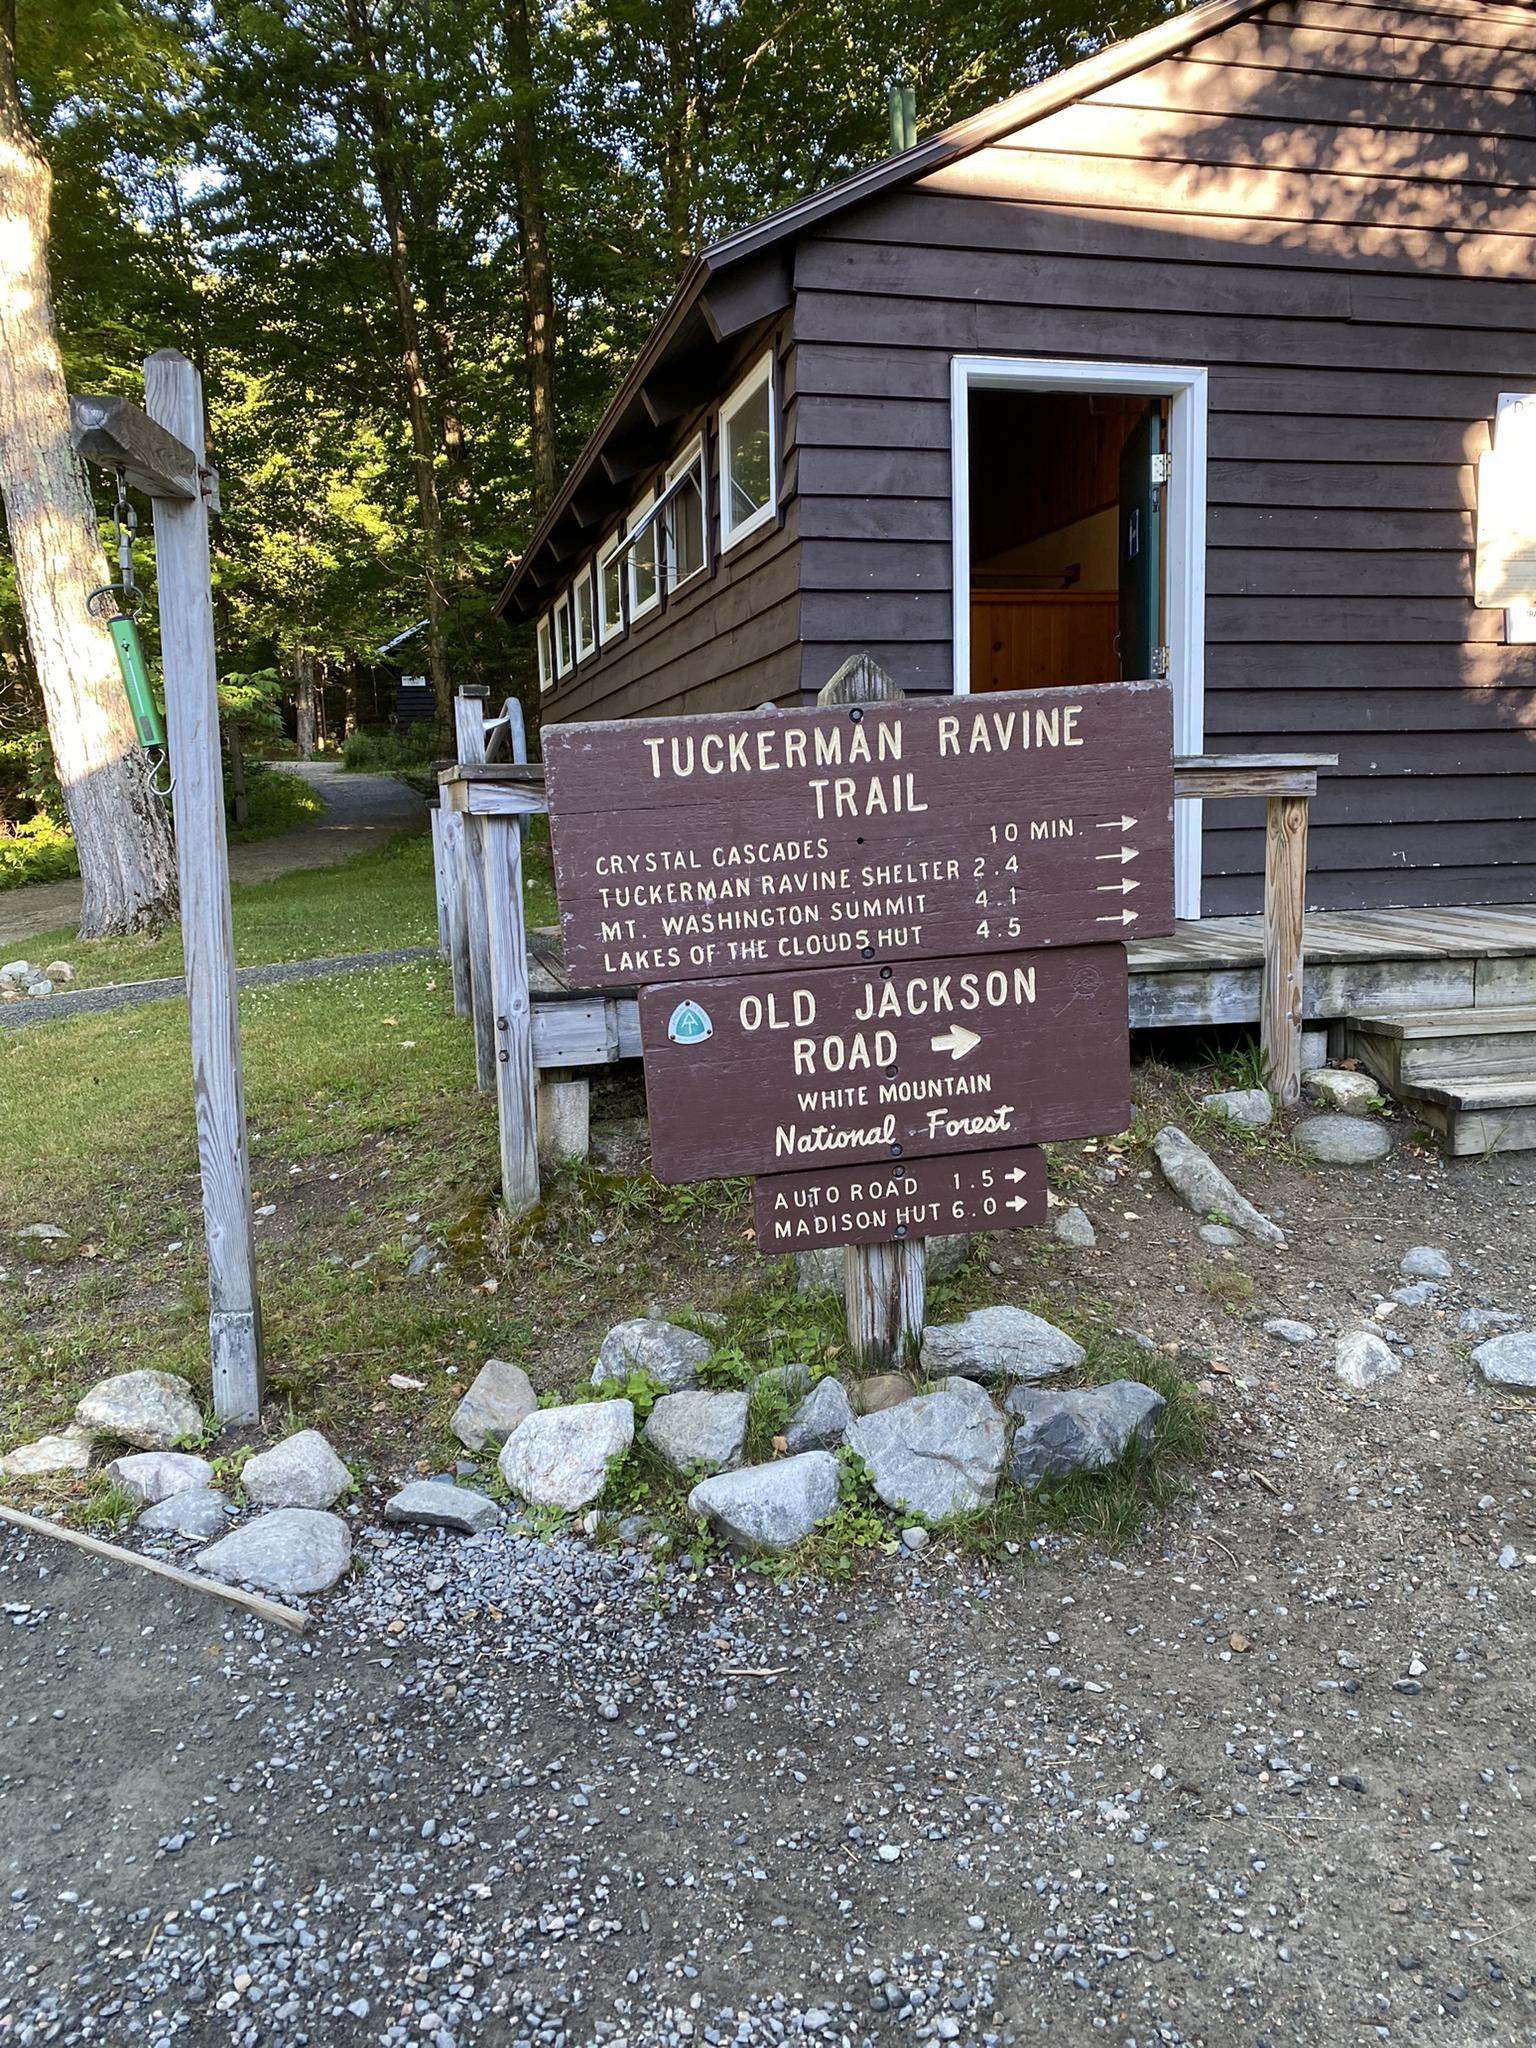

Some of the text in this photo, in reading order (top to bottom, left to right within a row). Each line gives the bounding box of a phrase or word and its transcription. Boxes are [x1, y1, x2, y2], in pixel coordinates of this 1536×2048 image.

[644, 705, 1084, 778] TUCKERMAN RAVINE
[809, 774, 928, 820] TRAIL
[595, 819, 1084, 876] CRYSTAL CASCADES 10 MIN.
[599, 878, 750, 910] TUCKERMAN
[761, 870, 850, 895] RAVINE
[862, 860, 960, 887] SHELTER
[601, 921, 646, 943] MT.
[662, 906, 819, 937] WASHINGTON
[831, 894, 926, 921] SUMMIT
[603, 948, 681, 973] LAKES
[690, 944, 716, 965] OF
[727, 939, 769, 961] THE
[778, 930, 870, 958] CLOUDS
[878, 926, 923, 948] HUT
[739, 989, 816, 1031] OLD
[855, 967, 1036, 1021] JACKSON
[793, 1030, 897, 1075] ROAD
[797, 1073, 991, 1112] WHITE MOUNTAIN
[775, 1105, 1014, 1157] National Forest
[774, 1185, 840, 1210] AUTO
[850, 1177, 918, 1201] ROAD
[774, 1209, 886, 1240] MADISON
[896, 1203, 940, 1226] HUT
